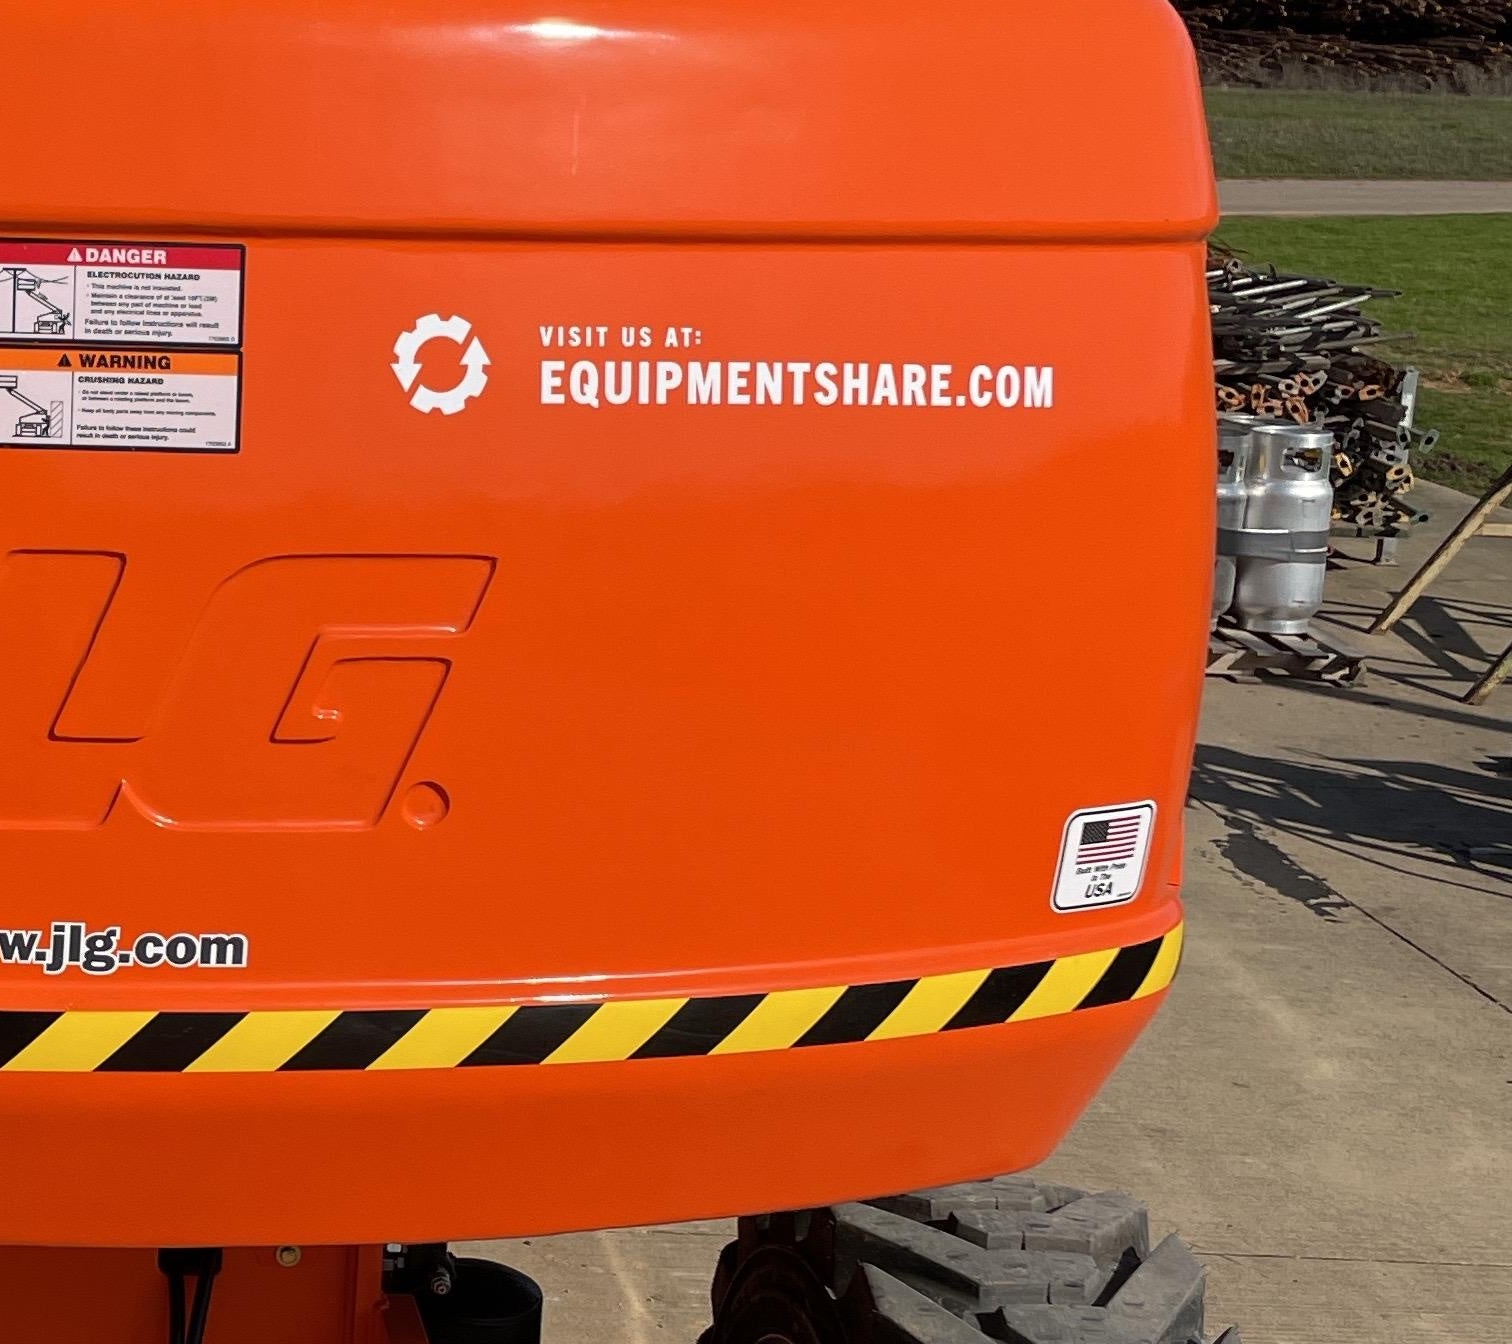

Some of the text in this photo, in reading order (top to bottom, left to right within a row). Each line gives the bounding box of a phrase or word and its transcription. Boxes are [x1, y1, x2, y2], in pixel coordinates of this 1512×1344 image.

[85, 248, 167, 265] DANGER
[87, 271, 200, 281] ELECTROCUTION HAZARD
[539, 325, 703, 348] VISIT US AT:
[79, 353, 171, 370] WARNING
[78, 376, 164, 385] CRUSHING HAZARD
[539, 360, 1055, 410] EQUIPMENTSHARE.COM
[1085, 882, 1113, 898] USA
